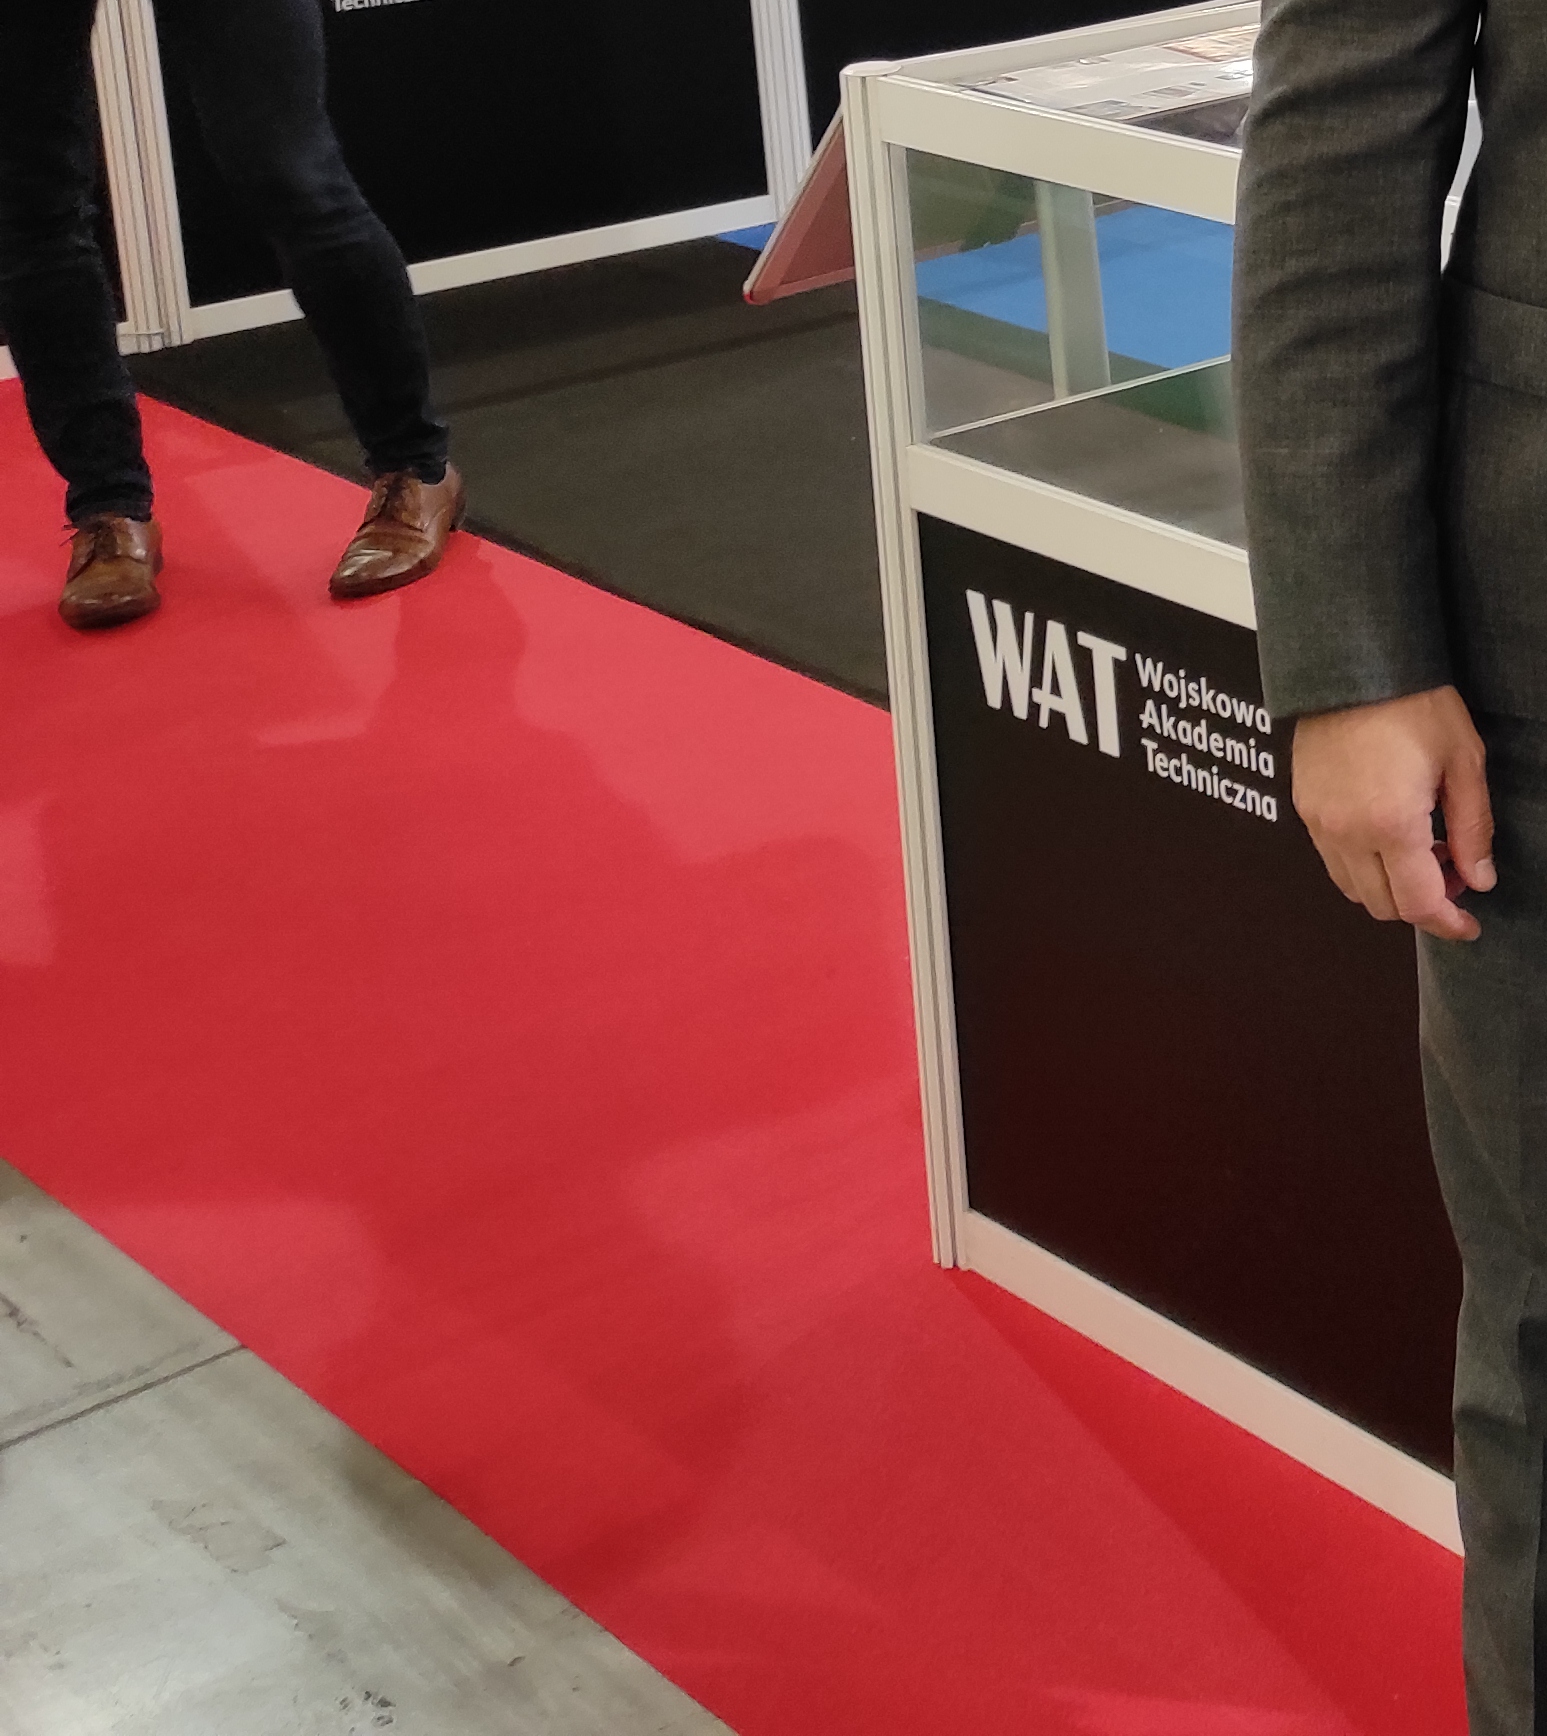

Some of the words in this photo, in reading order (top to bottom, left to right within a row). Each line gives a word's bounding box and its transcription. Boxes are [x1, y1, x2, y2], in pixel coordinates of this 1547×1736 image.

[966, 588, 1127, 758] WAT
[1135, 653, 1272, 735] Wojskowa
[1139, 699, 1275, 779] Akademia
[1141, 738, 1278, 823] Techniczna
